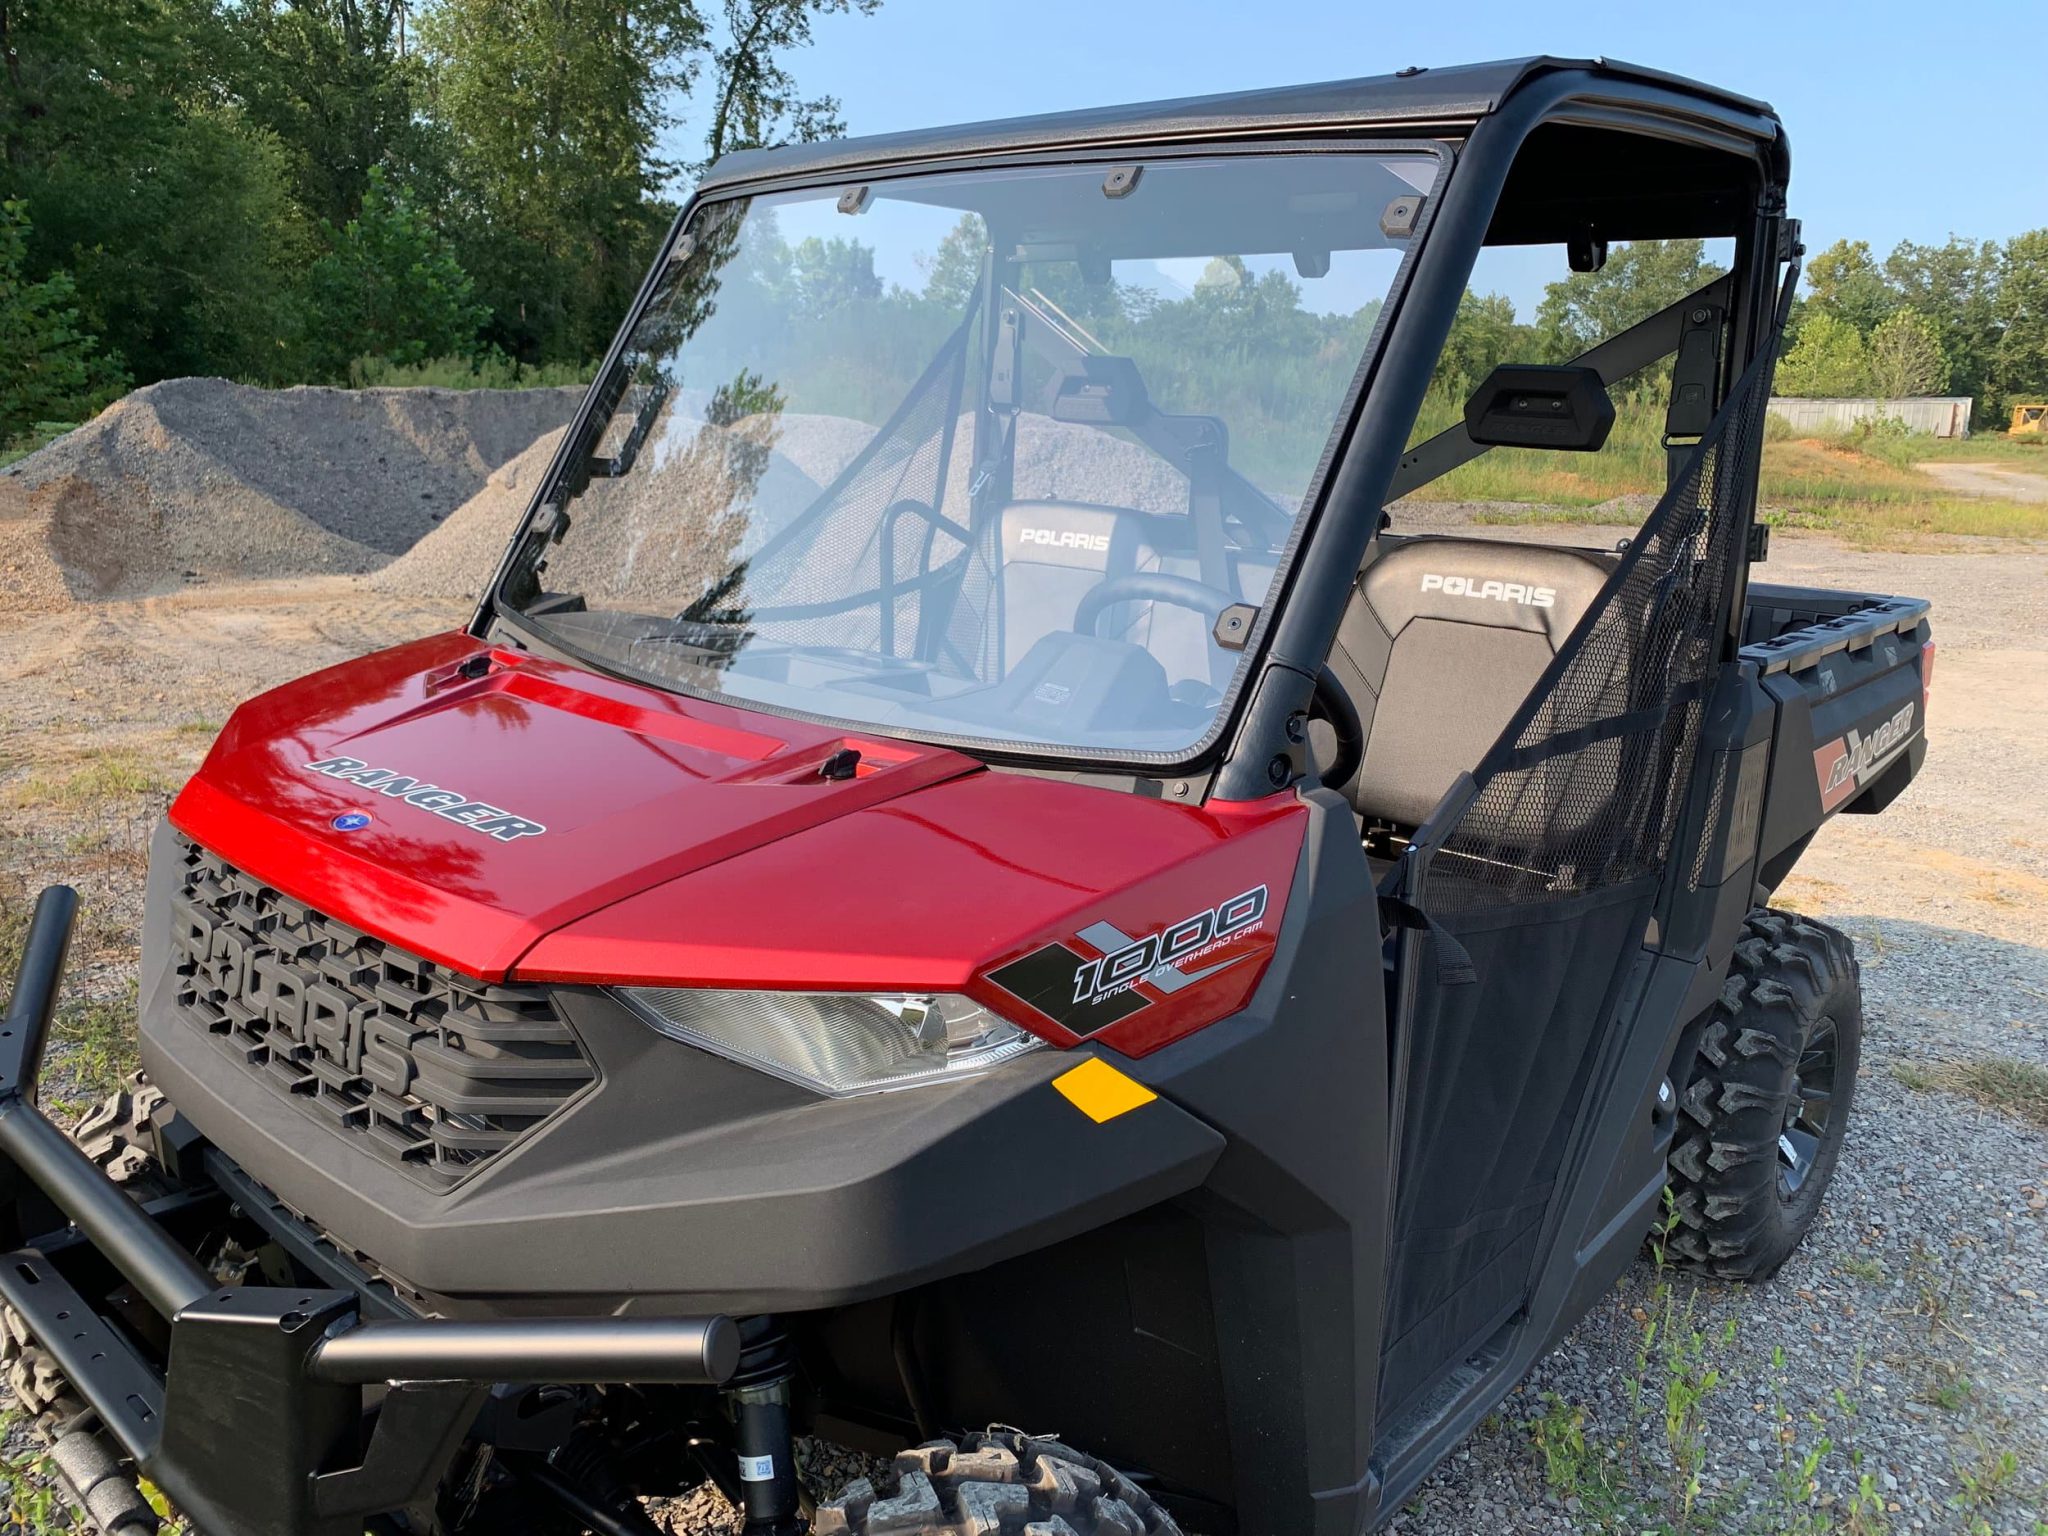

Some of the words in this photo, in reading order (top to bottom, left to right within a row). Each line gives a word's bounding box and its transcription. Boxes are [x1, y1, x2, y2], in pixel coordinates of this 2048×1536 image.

[1020, 528, 1109, 551] POLARIS
[1421, 574, 1556, 607] POLARIS
[1824, 702, 1914, 793] RANGER
[305, 756, 546, 841] RANGER
[1072, 884, 1269, 1004] 1000
[1092, 973, 1149, 1005] SINGLE
[1155, 937, 1231, 977] OVERHEAD
[1234, 921, 1263, 941] CAM
[180, 903, 423, 1095] POLARIS
